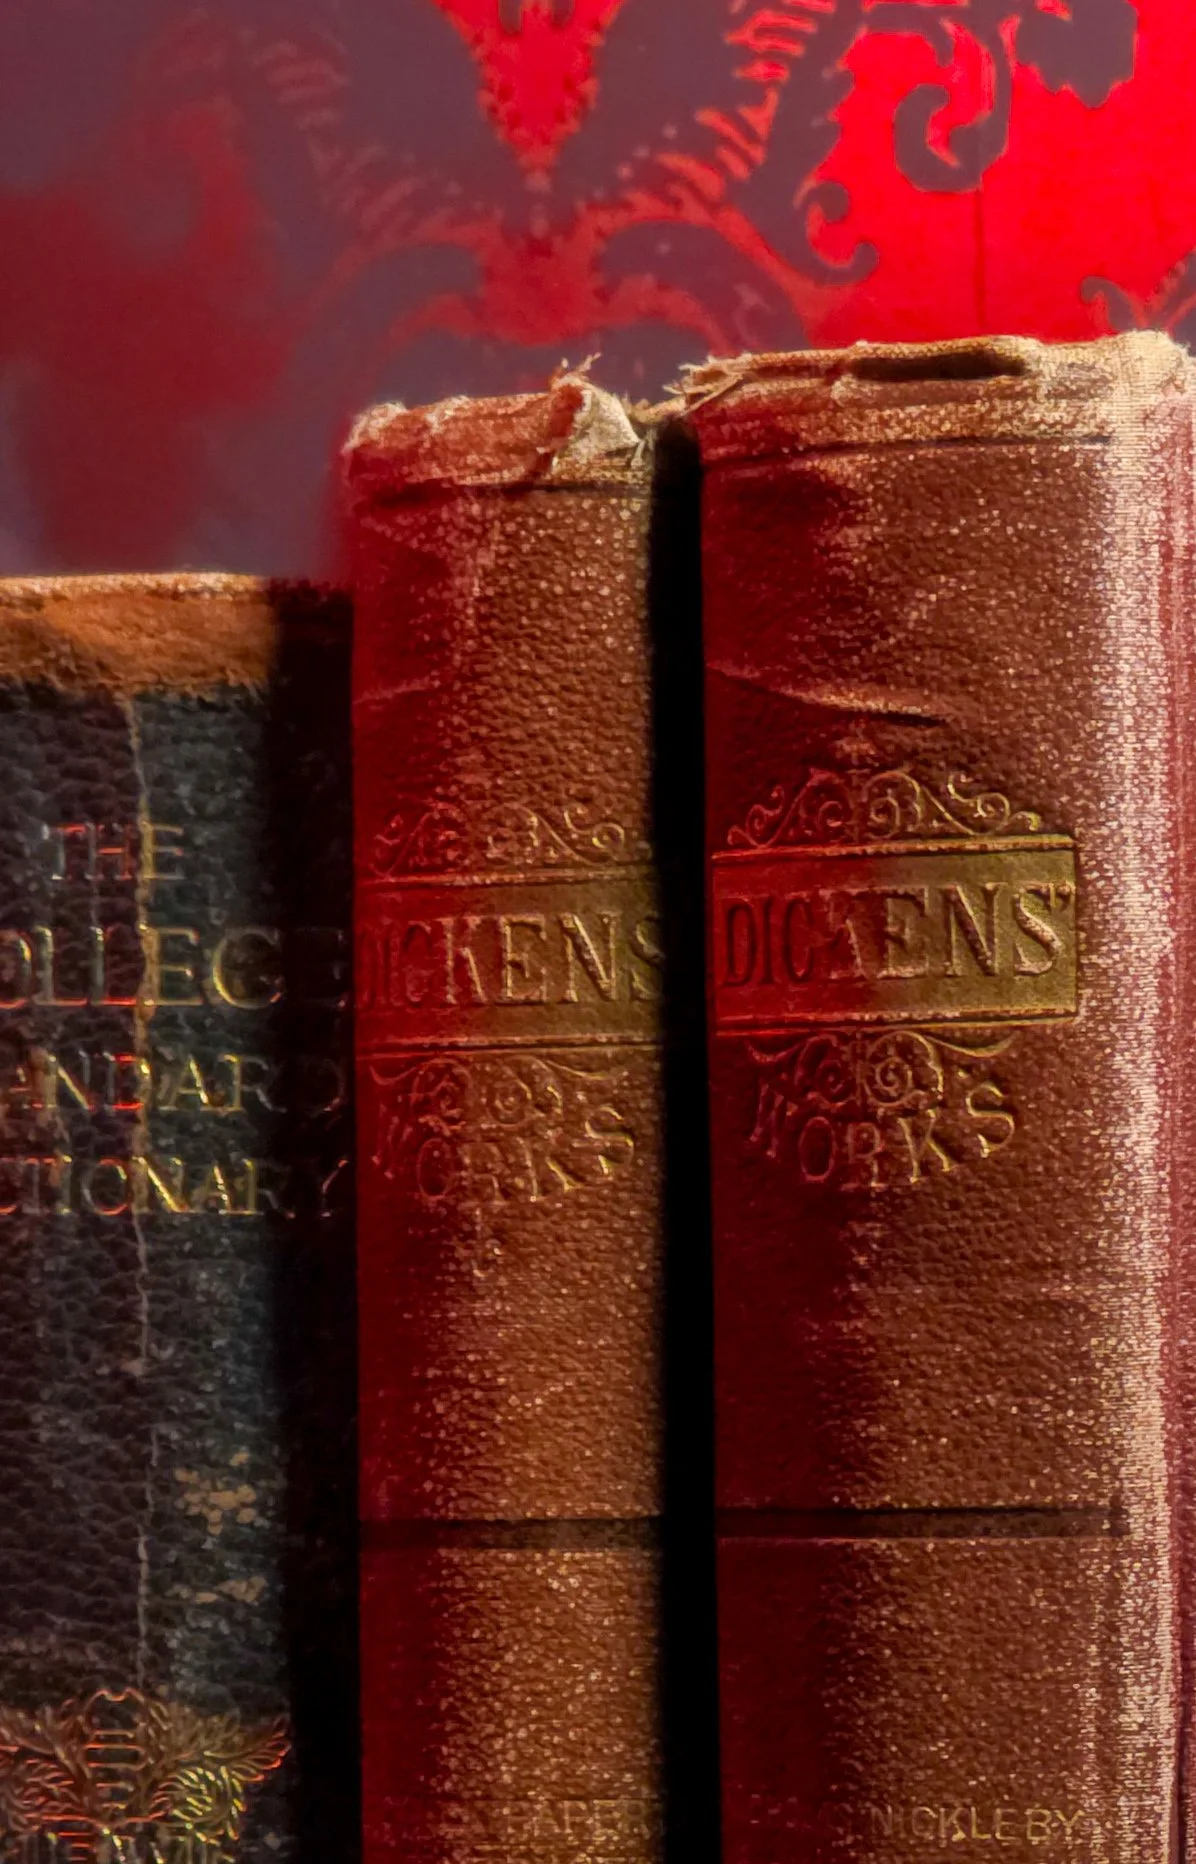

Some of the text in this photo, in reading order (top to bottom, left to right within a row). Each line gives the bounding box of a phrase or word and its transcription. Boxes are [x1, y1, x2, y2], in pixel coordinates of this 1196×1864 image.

[42, 822, 186, 881] THE
[370, 1104, 636, 1203] WORKS
[749, 1080, 1016, 1188] WORKS
[867, 1804, 1086, 1843] NICKLEBY
